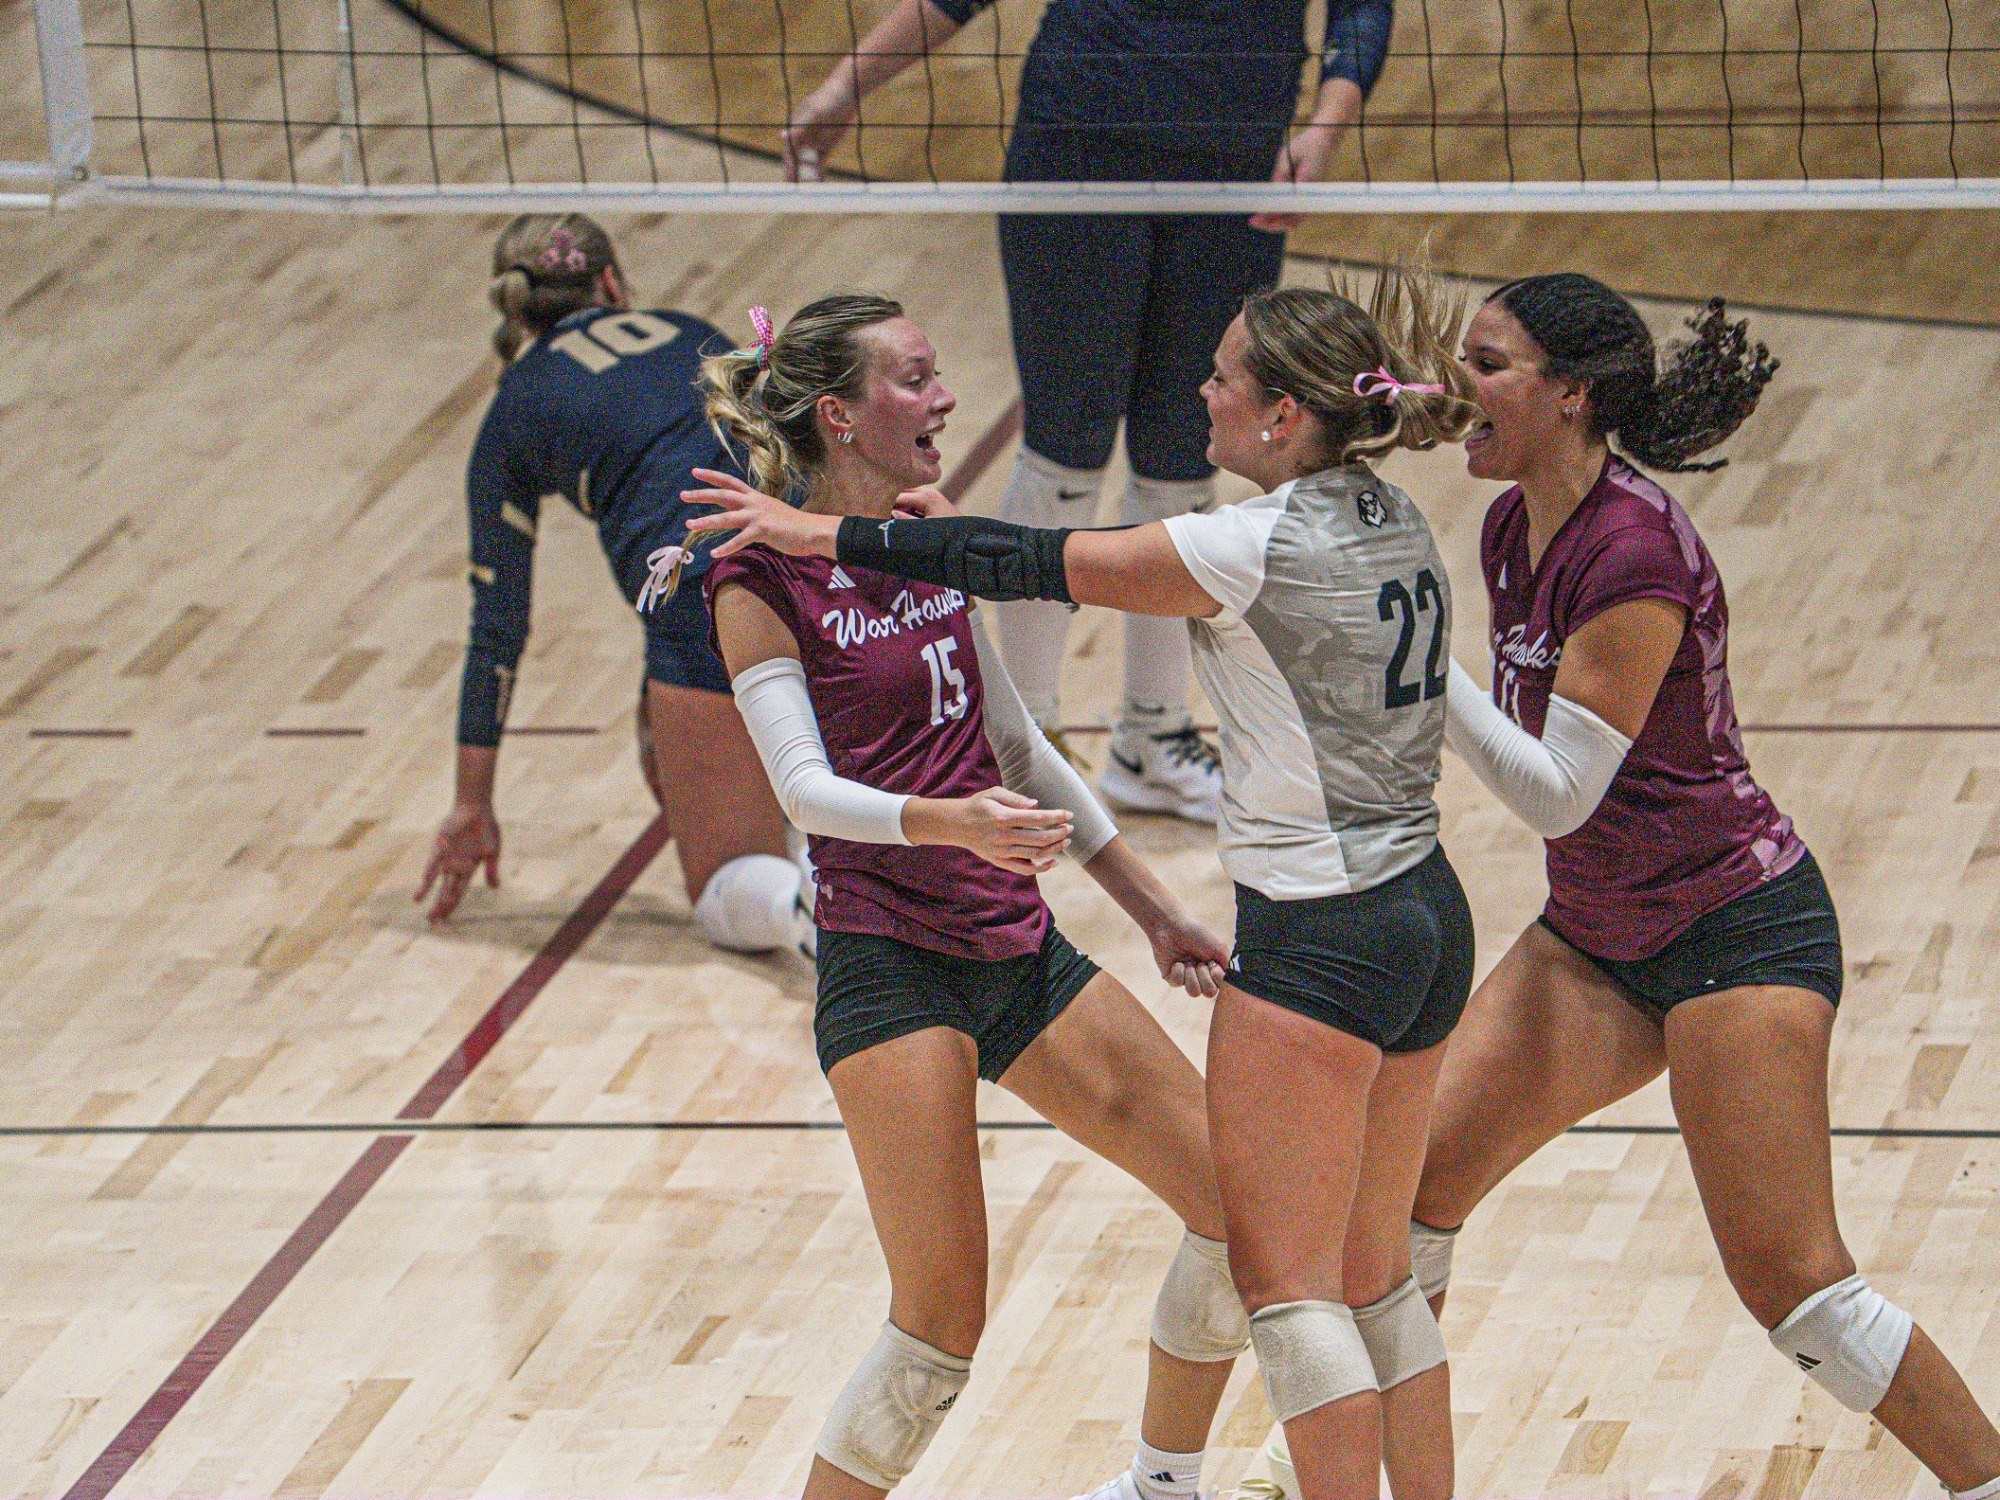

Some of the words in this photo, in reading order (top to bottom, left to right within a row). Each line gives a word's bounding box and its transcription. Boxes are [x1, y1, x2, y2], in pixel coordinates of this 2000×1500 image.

[548, 311, 682, 374] 10
[822, 608, 899, 649] War
[1377, 568, 1447, 711] 22
[920, 635, 969, 726] 15
